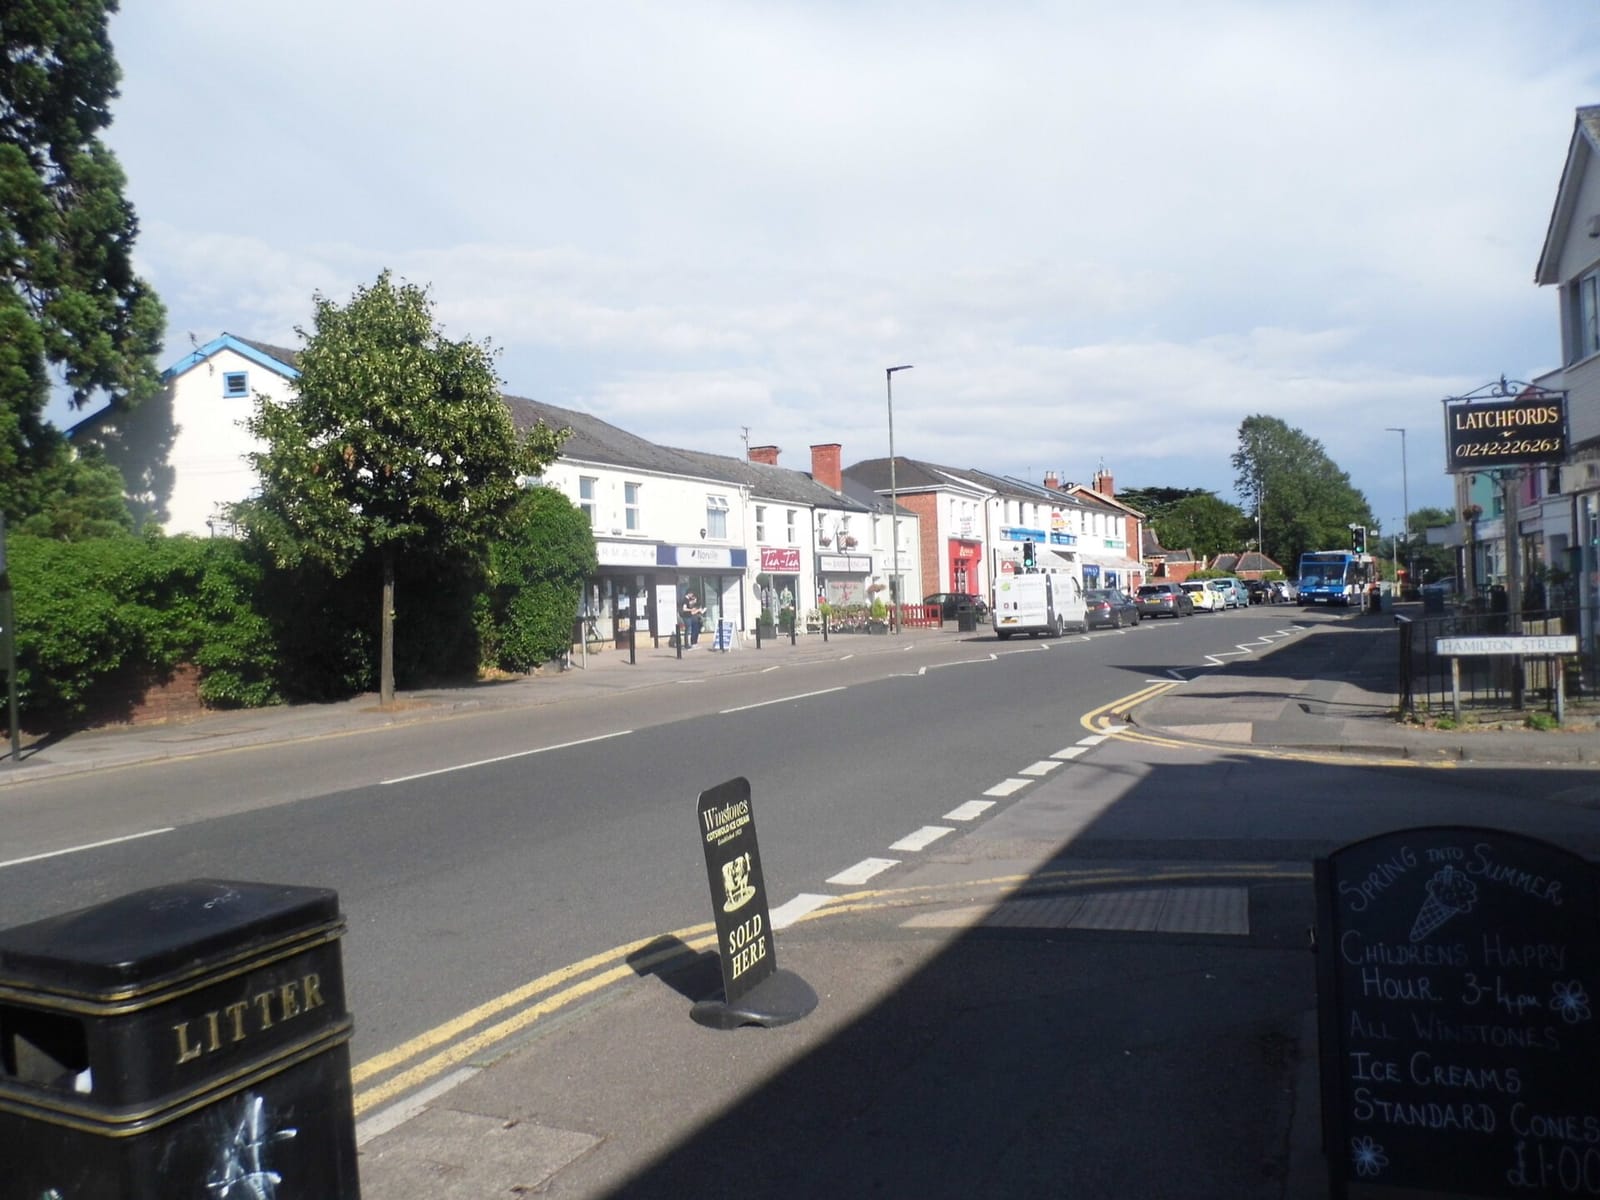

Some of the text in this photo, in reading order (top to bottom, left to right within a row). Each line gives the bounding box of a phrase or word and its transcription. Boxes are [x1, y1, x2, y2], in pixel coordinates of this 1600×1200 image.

[1456, 406, 1559, 430] LATCHFORDS
[1442, 639, 1569, 652] HAMILTON STREET
[703, 799, 749, 832] Winstones
[1465, 843, 1563, 905] SUMMER
[729, 913, 762, 955] SOLD
[1482, 932, 1567, 972] HAPPY
[732, 936, 766, 980] HERE
[172, 972, 327, 1065] LITTER
[1350, 1009, 1401, 1041] ALL
[1349, 1050, 1521, 1094] ICE CREAMS
[1353, 1087, 1600, 1144] STANDARD CONES
